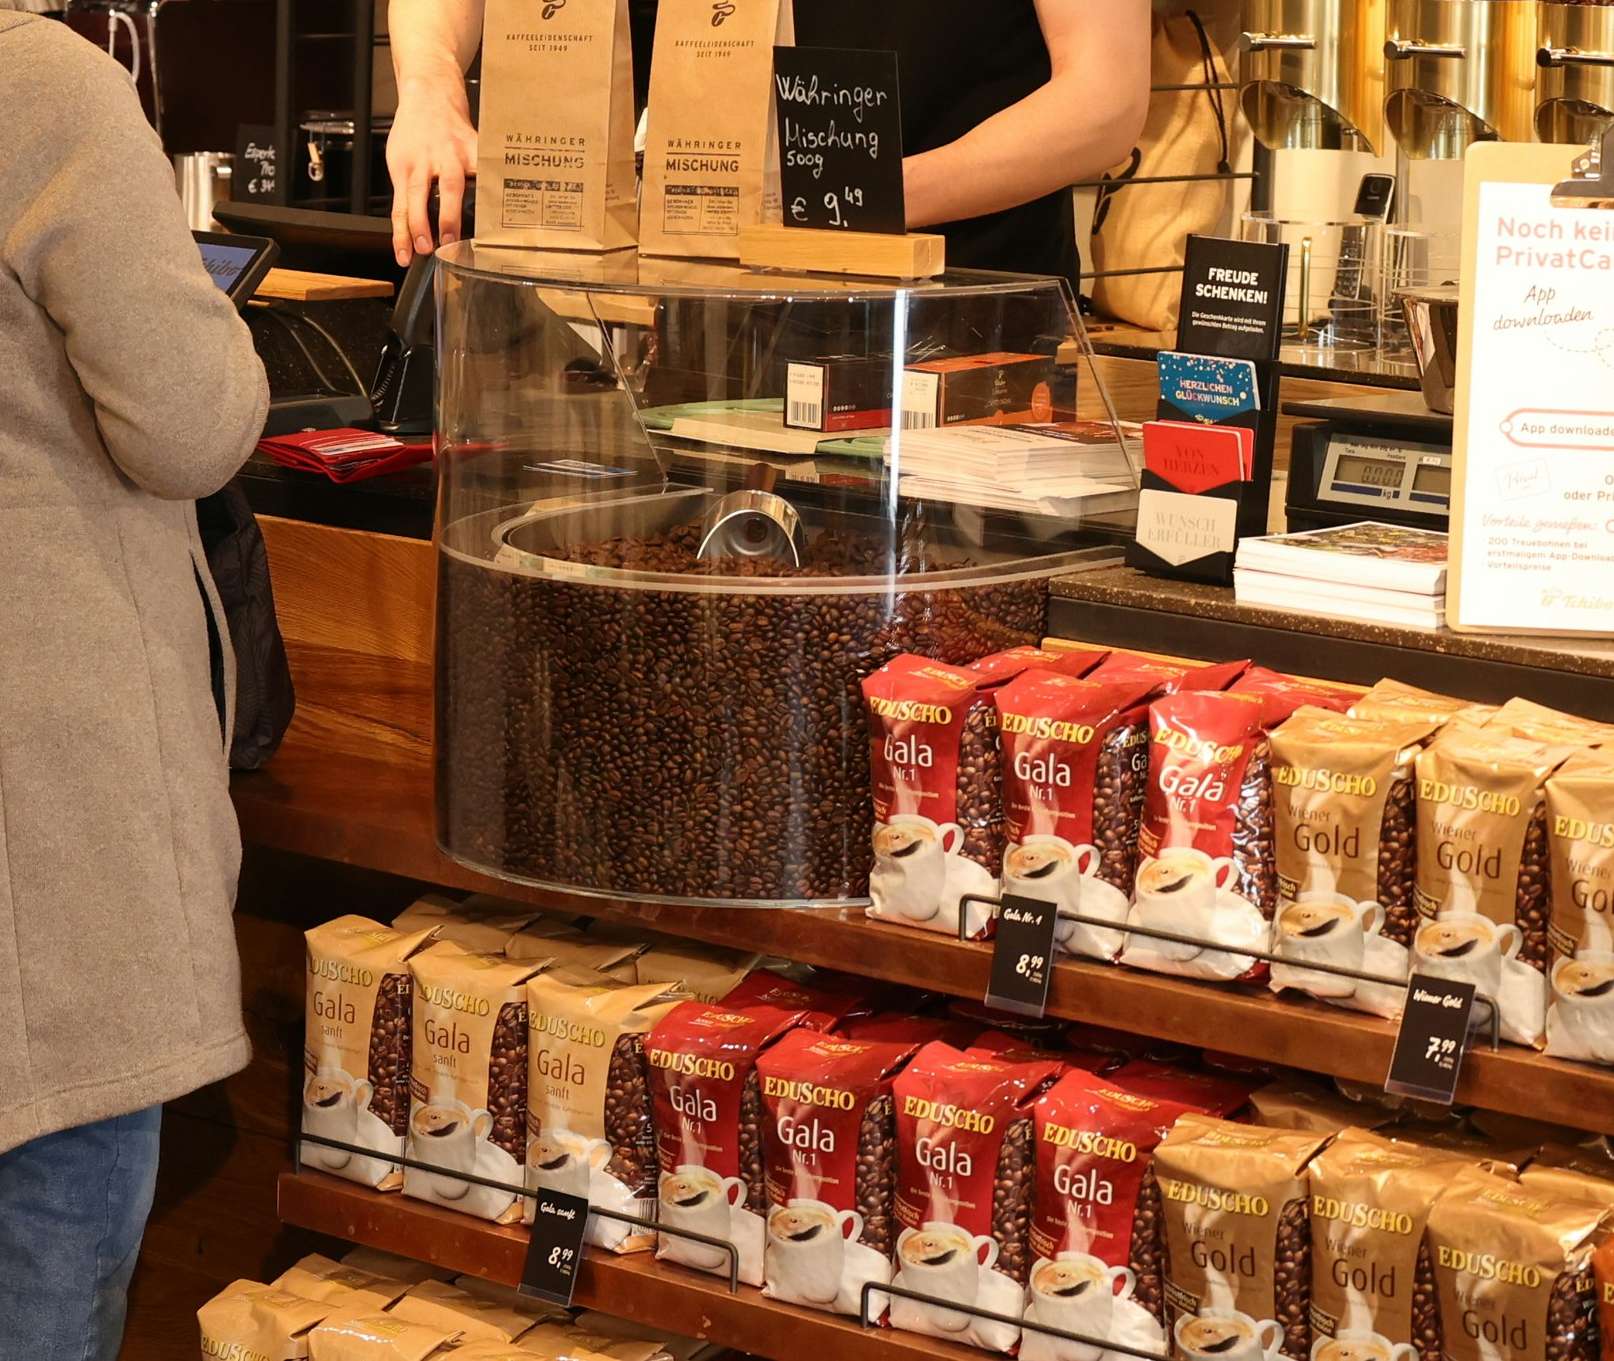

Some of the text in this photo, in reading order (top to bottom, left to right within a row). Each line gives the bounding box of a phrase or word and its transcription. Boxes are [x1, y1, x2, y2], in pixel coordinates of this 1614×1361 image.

[506, 34, 593, 42] KAFFEELEIDENSCHAFT
[528, 44, 568, 53] SEIT 1949
[675, 40, 755, 48] KAFFEELEIDENSCHAFT
[696, 50, 713, 58] SEIT
[775, 74, 887, 124] Währinger
[505, 133, 585, 147] WÄHRINGER
[667, 139, 741, 150] WÄHRINGER
[785, 117, 879, 159] Mischung
[504, 153, 584, 169] MISCHUNG
[666, 159, 739, 173] MISCHUNG
[787, 150, 824, 179] 500g
[790, 197, 808, 221] €
[1497, 217, 1563, 240] Noch
[1208, 268, 1258, 285] FREUDE
[1195, 284, 1268, 304] SCHENKEN!
[1524, 284, 1556, 305] App
[1493, 307, 1594, 330] downloaden
[1176, 390, 1239, 406] GLÜCKWUNSCH
[1179, 379, 1233, 394] HERZLICHEN
[1520, 423, 1545, 435] App
[1564, 490, 1592, 500] oder
[869, 696, 952, 725] EDUSCHO
[1001, 712, 1094, 744] EDUSCHO
[884, 734, 933, 767] Gala
[893, 767, 917, 782] Nr.1
[1014, 752, 1071, 787] Gala
[1277, 765, 1377, 797] EDUSCHO
[1030, 785, 1054, 801] Nr.1
[1159, 767, 1223, 802] Gala
[1171, 797, 1196, 813] Nr.1
[1420, 779, 1522, 817] EDUSCHO
[1287, 805, 1330, 822] Wiener
[1294, 823, 1360, 859] Gold
[1431, 820, 1477, 840] Wiener
[1436, 841, 1502, 879] Gold
[1015, 953, 1045, 977] 8,99
[1425, 1036, 1456, 1063] 7,99
[538, 1049, 586, 1086] Gala
[649, 1048, 734, 1082] EDUSCHO
[670, 1085, 717, 1123] Gala
[764, 1076, 855, 1111] EDUSCHO
[904, 1095, 995, 1136] EDUSCHO
[777, 1116, 835, 1153] Gala
[1043, 1122, 1137, 1163] EDUSCHO
[915, 1137, 972, 1177] Gala
[1053, 1164, 1113, 1206] Gala
[1168, 1179, 1269, 1217] EDUSCHO
[548, 1246, 573, 1269] 8,99
[1190, 1240, 1256, 1277] Gold
